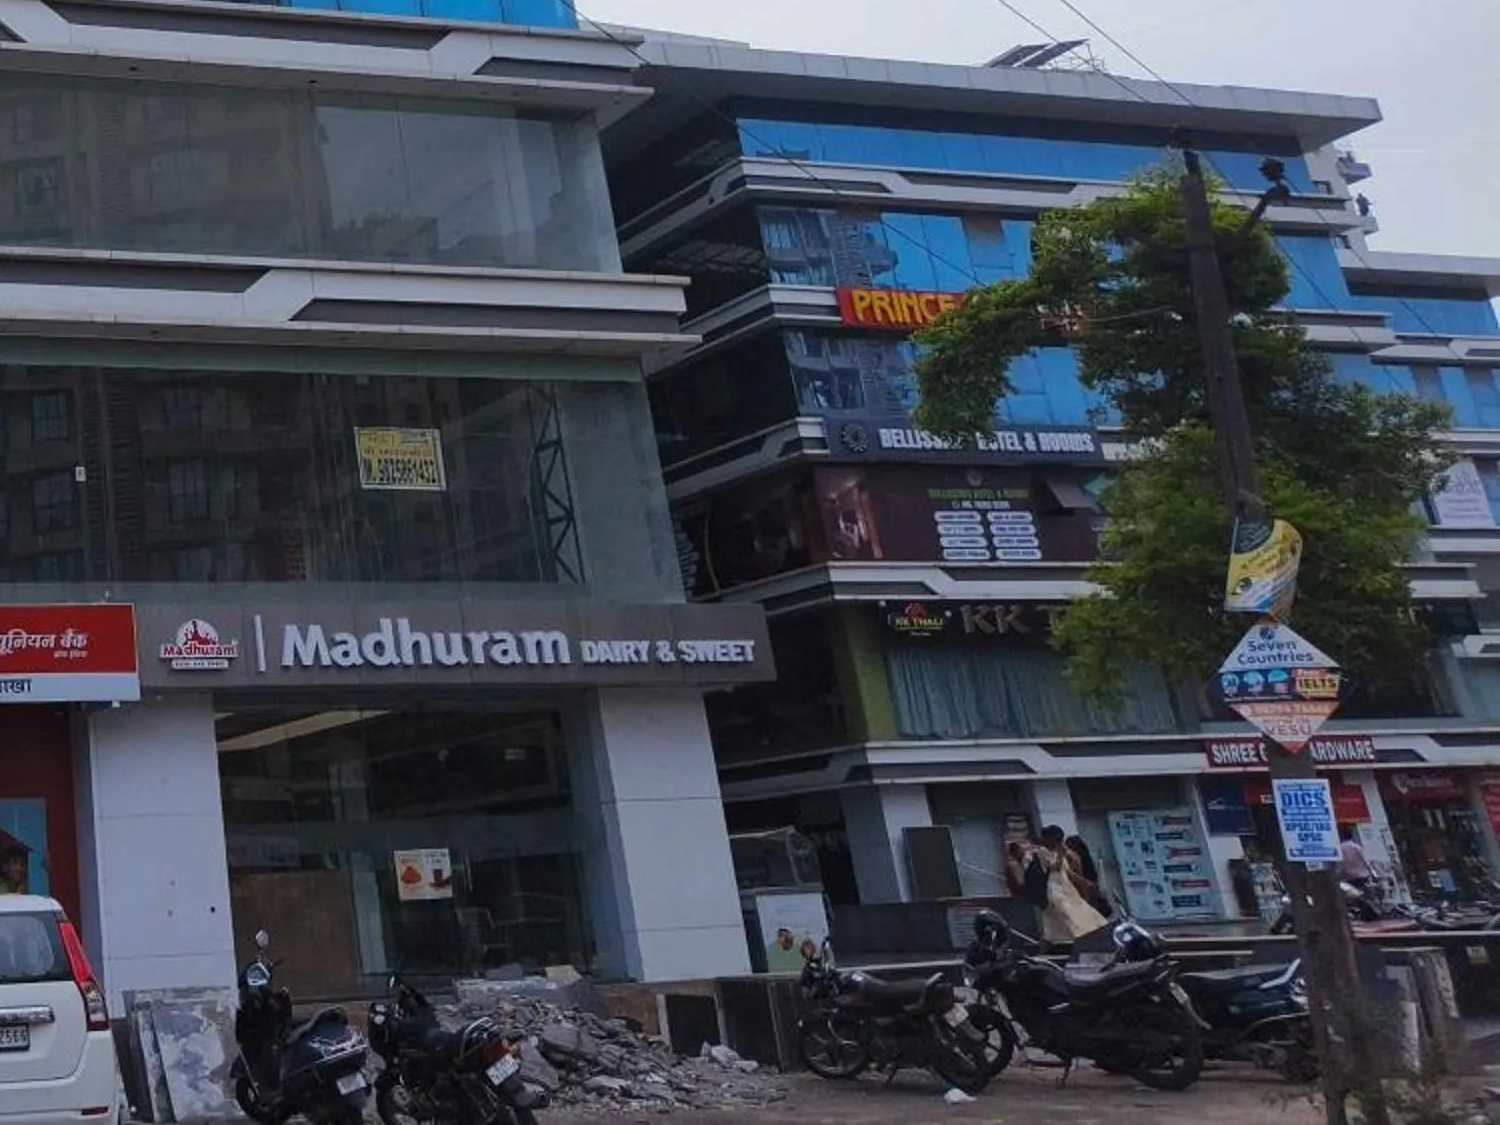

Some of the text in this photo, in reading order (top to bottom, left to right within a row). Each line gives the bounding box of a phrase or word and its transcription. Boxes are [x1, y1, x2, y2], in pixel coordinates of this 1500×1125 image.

[162, 642, 236, 656] Madhuram
[281, 618, 755, 669] Madhuram DAIRY & SWEET
[1248, 640, 1298, 652] Seven
[1237, 651, 1314, 665] Countries
[1298, 678, 1337, 689] IELTS
[1266, 725, 1313, 736] VESU
[1211, 742, 1258, 764] SHREE
[1309, 738, 1375, 761] ARDWARE
[1281, 792, 1326, 807] DICS
